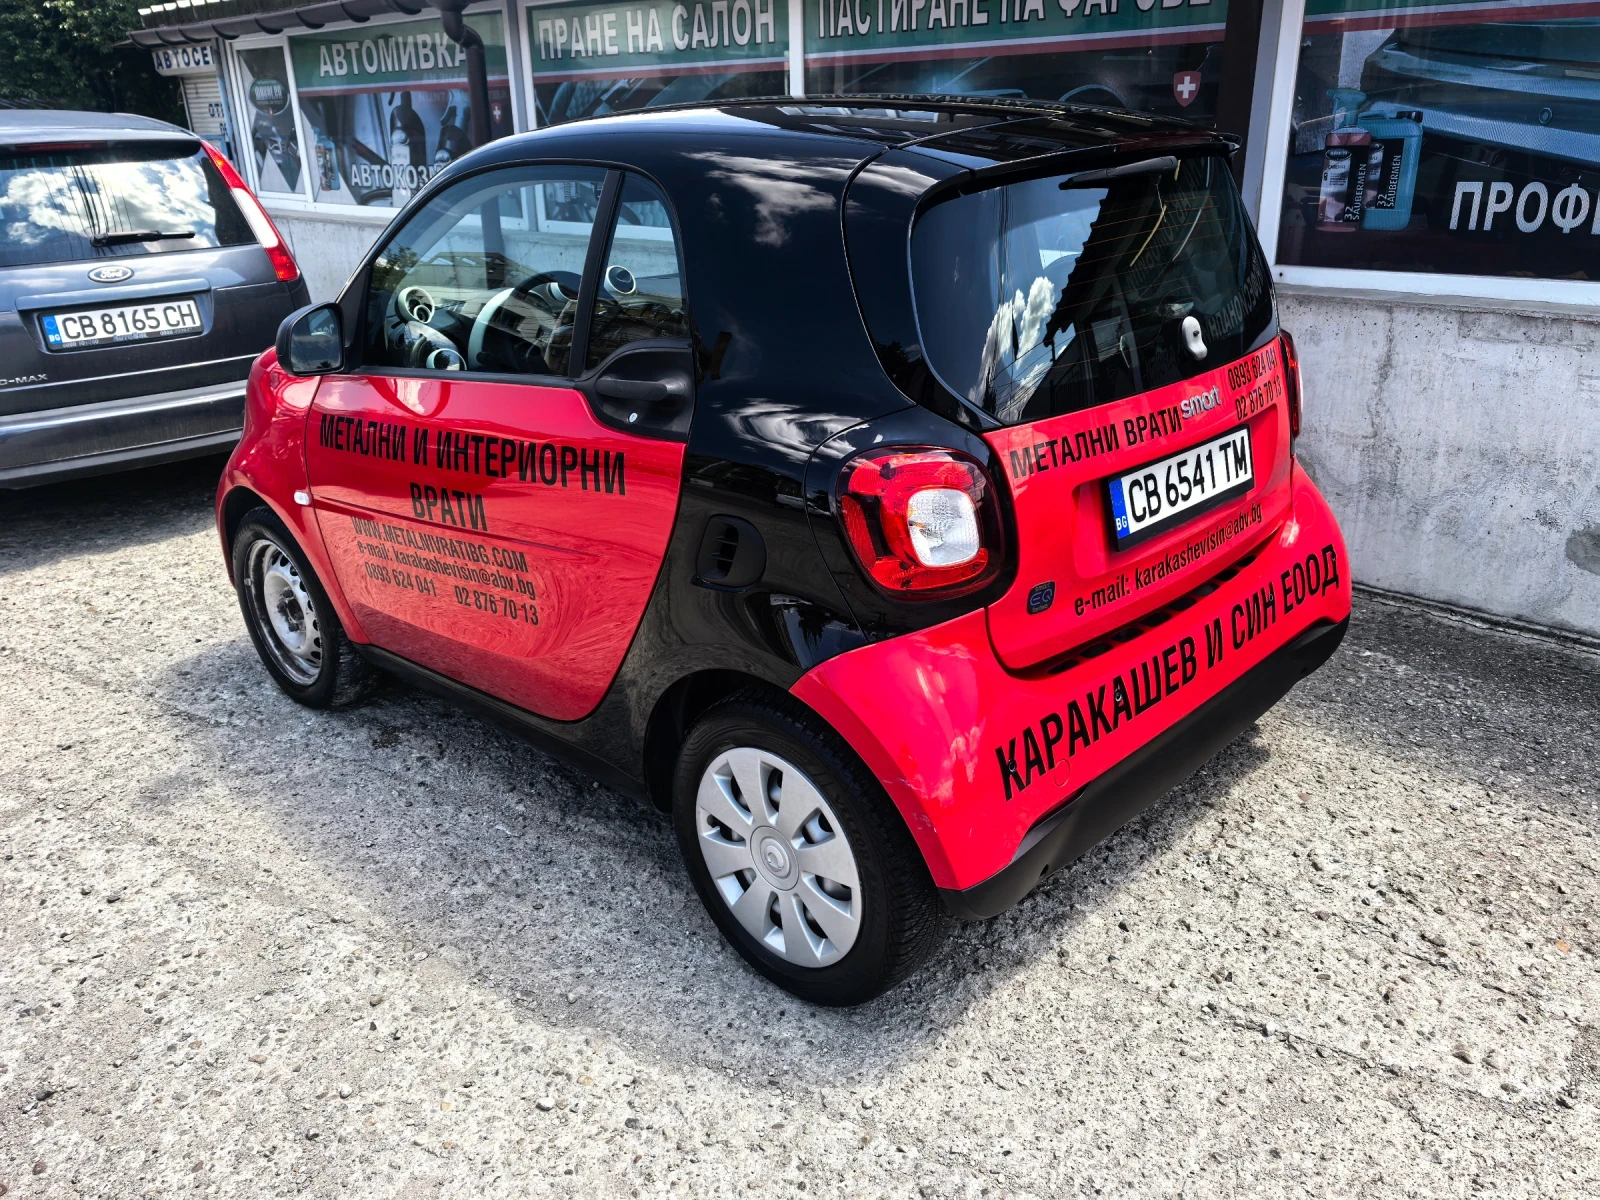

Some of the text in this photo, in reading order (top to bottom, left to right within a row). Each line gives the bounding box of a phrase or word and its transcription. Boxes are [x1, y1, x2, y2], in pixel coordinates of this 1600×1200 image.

[319, 32, 467, 77] АВТОМИВКА
[538, 0, 776, 60] ПРАНЕ НА САЛОН
[1353, 163, 1367, 220] SAUBERMEN
[1387, 155, 1401, 207] SAUBERMEN
[1450, 181, 1600, 235] ПРОФ
[49, 334, 61, 342] BG
[101, 307, 160, 338] 8165
[1227, 345, 1278, 391] 0893 624 041
[1180, 386, 1222, 419] smart
[1235, 375, 1282, 421] 02 876 70 13
[319, 413, 626, 496] МЕТАЛНИ И ИНТЕРИОРНИ
[1009, 405, 1183, 479] МЕТАЛНИ ВРАТИ
[1165, 449, 1216, 508] 6541
[409, 481, 488, 532] ВРАТИ
[1115, 515, 1128, 530] BG
[351, 515, 529, 573] WWW.METALNIVRATIBG.COM
[1074, 502, 1262, 617] e-mail: karakashevisin@abv.bg
[357, 541, 536, 601] e-mail: karakashevisin@abv.bg
[364, 561, 437, 597] 0893 624 041
[454, 585, 539, 626] 02 876 70 13
[1029, 589, 1053, 607] EQ
[995, 543, 1340, 802] КАРАКАШЕВ И СИН ЕООД
